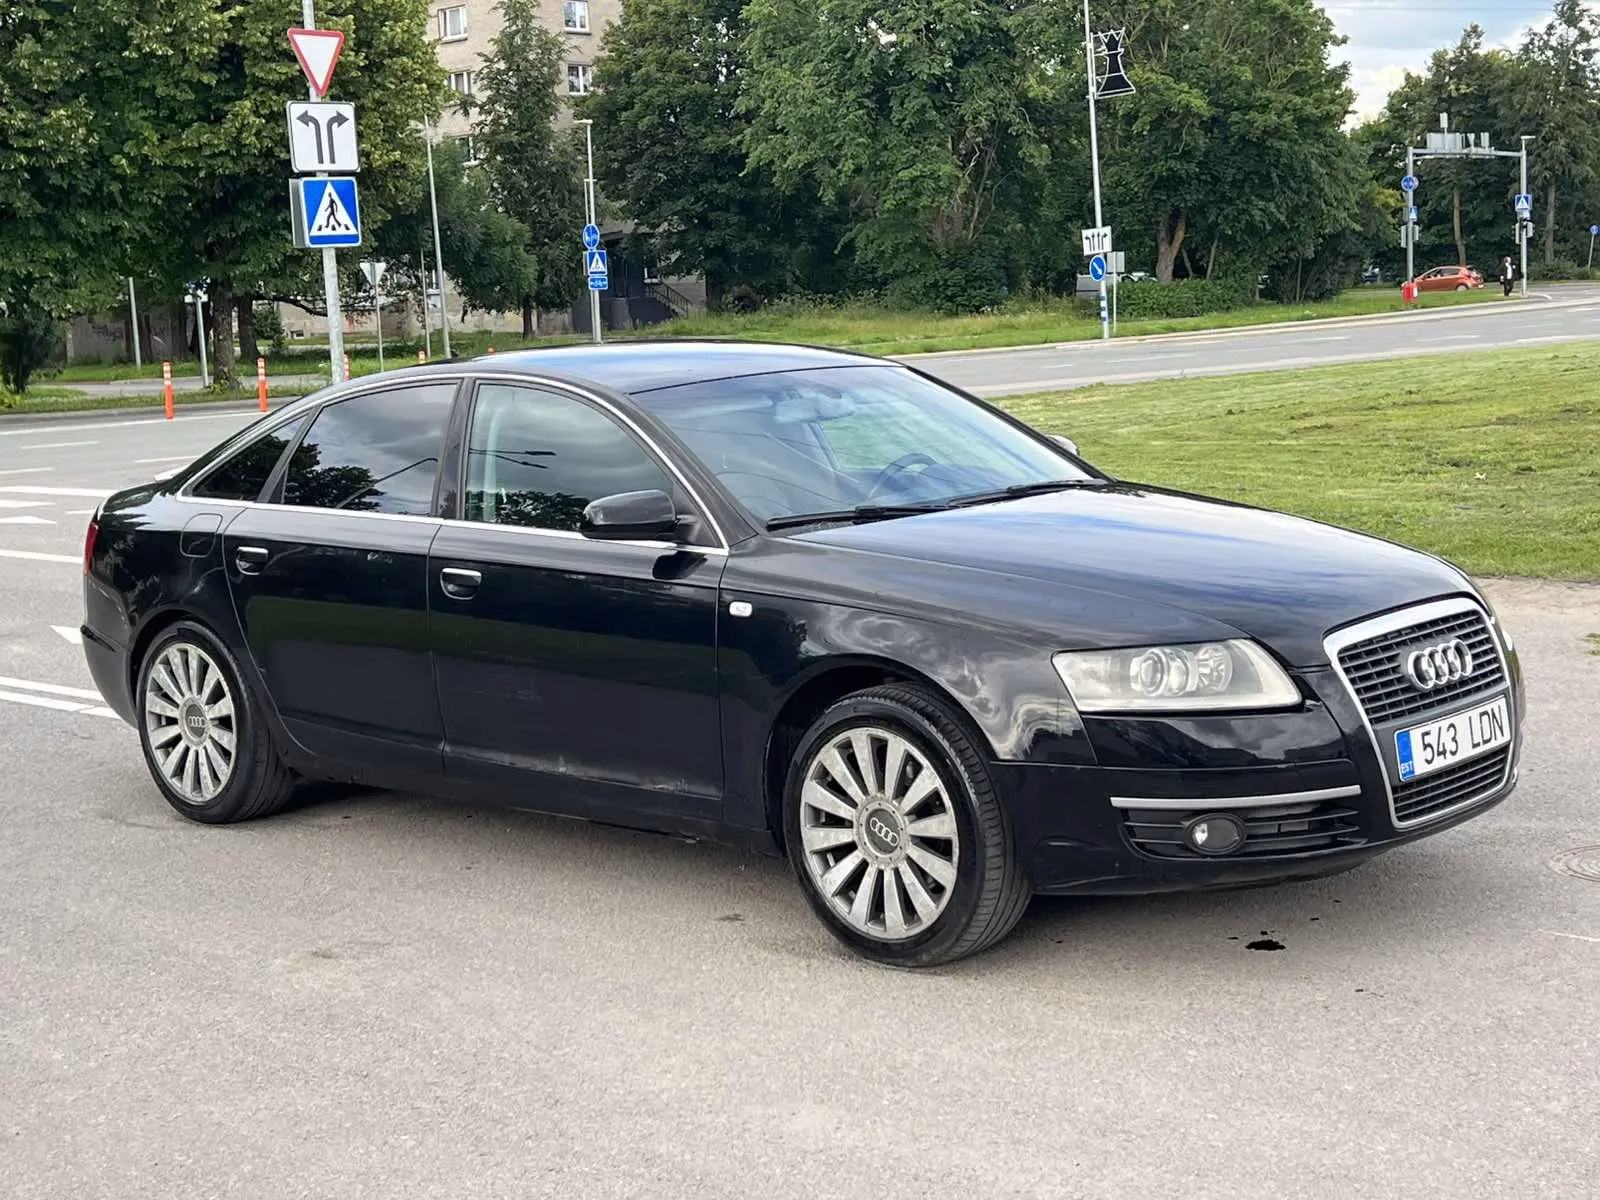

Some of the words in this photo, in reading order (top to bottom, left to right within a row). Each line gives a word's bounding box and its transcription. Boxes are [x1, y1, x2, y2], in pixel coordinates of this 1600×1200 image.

[1421, 722, 1459, 765] 543
[1468, 705, 1505, 749] LDN
[1400, 760, 1413, 774] EST
